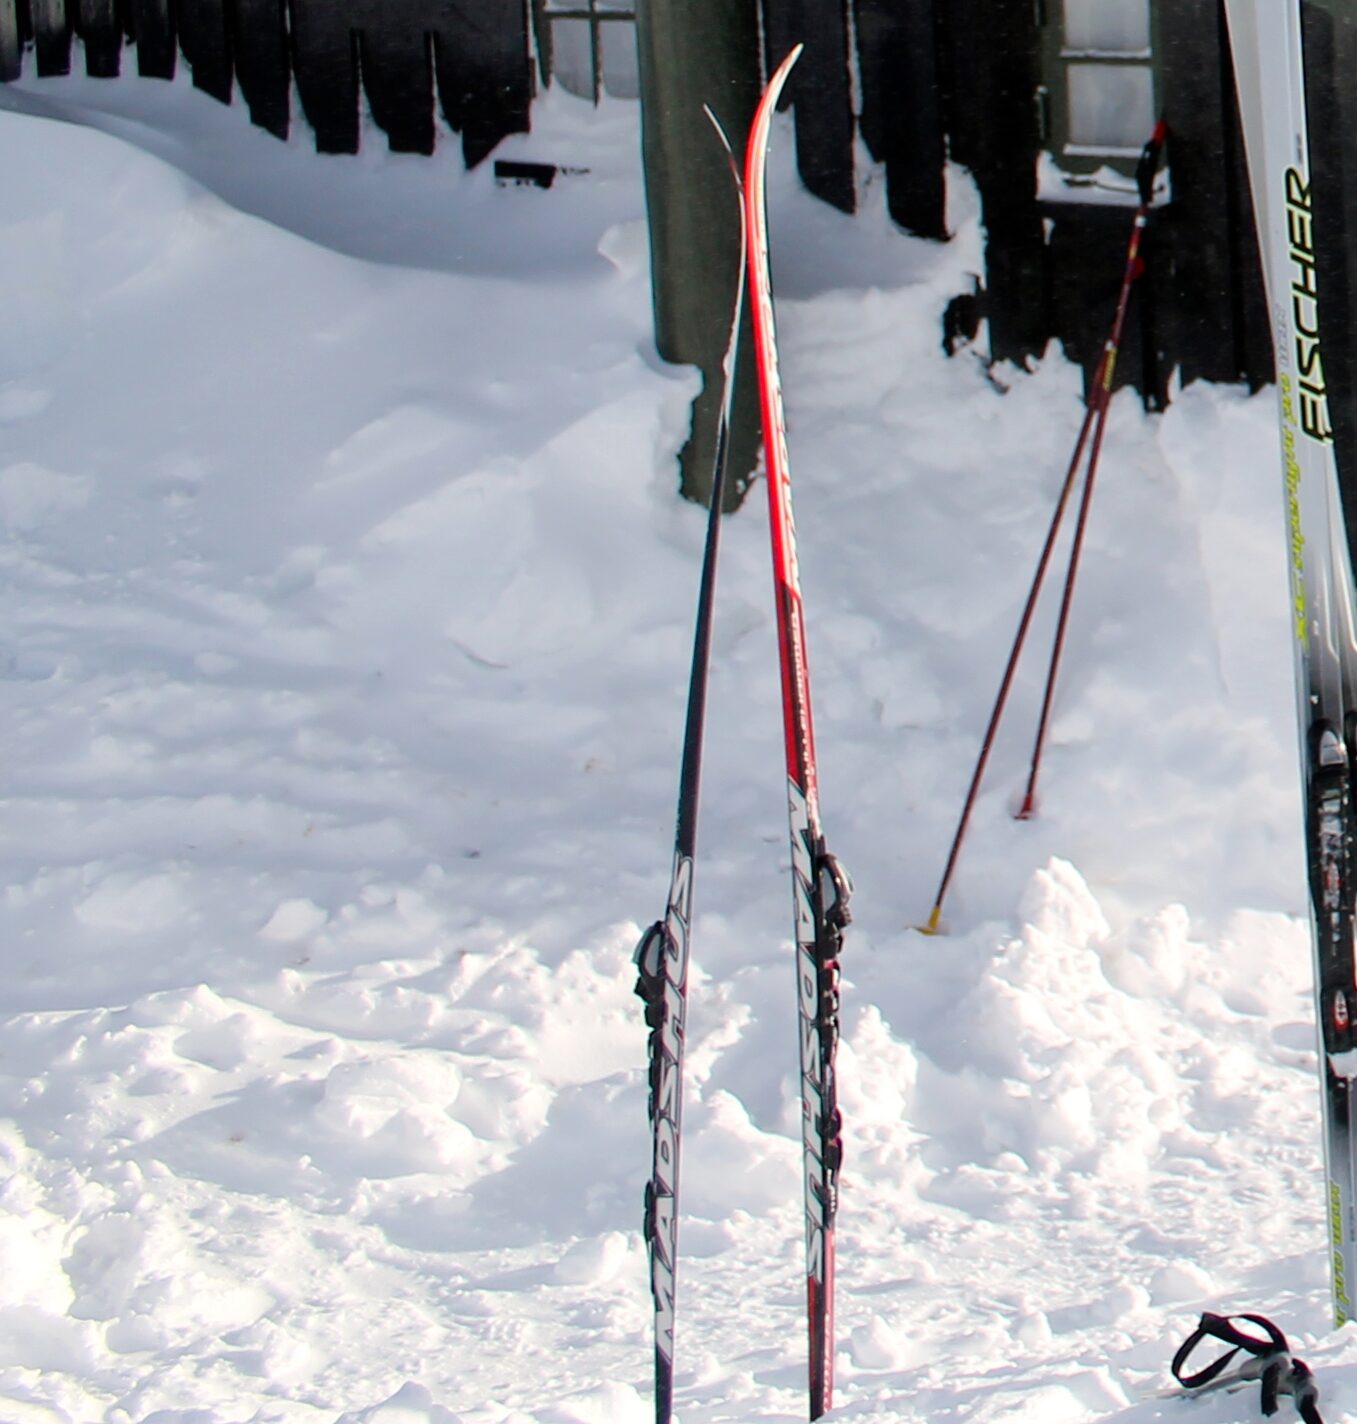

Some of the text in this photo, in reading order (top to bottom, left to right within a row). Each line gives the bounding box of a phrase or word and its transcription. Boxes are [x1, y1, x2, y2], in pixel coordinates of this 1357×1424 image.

[1285, 167, 1334, 444] FISCHER
[655, 849, 696, 1362] MADSHUS
[788, 777, 823, 1278] MADSHUS
